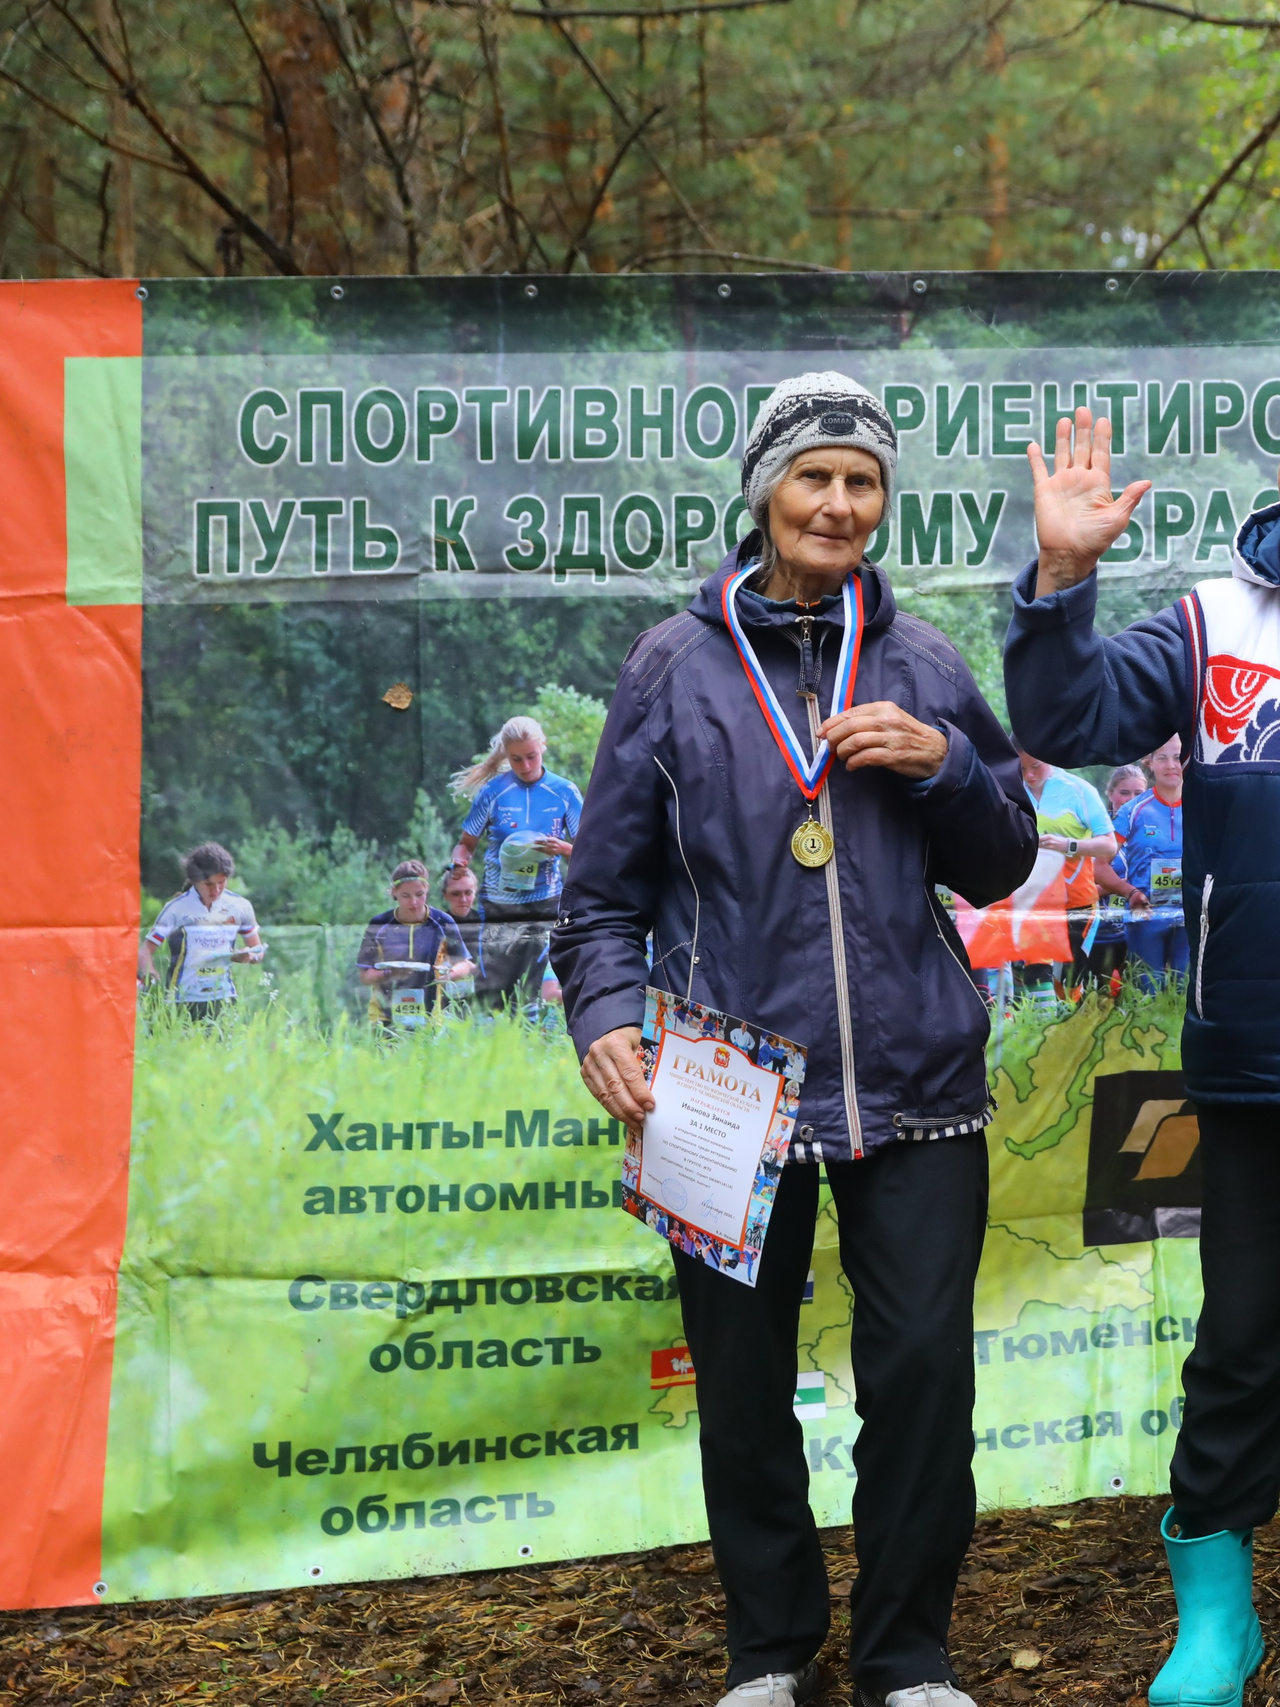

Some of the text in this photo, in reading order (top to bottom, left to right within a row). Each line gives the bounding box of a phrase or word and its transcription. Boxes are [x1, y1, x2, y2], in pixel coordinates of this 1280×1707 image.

[823, 417, 852, 425] LOMAN
[199, 500, 400, 575] ПУТЬ
[434, 498, 475, 571] К
[504, 491, 1004, 584] ЗДОРМУ
[672, 1053, 761, 1103] ГРАМОТА
[682, 1102, 741, 1130] Иванова Зинаида
[690, 1097, 731, 1116] НАГРАЖДАЕТСЯ
[304, 1110, 628, 1153] Ханты-Ман
[689, 1119, 698, 1127] ЗА
[704, 1125, 727, 1138] МЕСТО
[303, 1180, 623, 1215] автономны
[369, 1335, 602, 1374] область
[974, 1314, 1198, 1366] Тюменс
[253, 1422, 639, 1478] Челябинская
[320, 1491, 556, 1536] область
